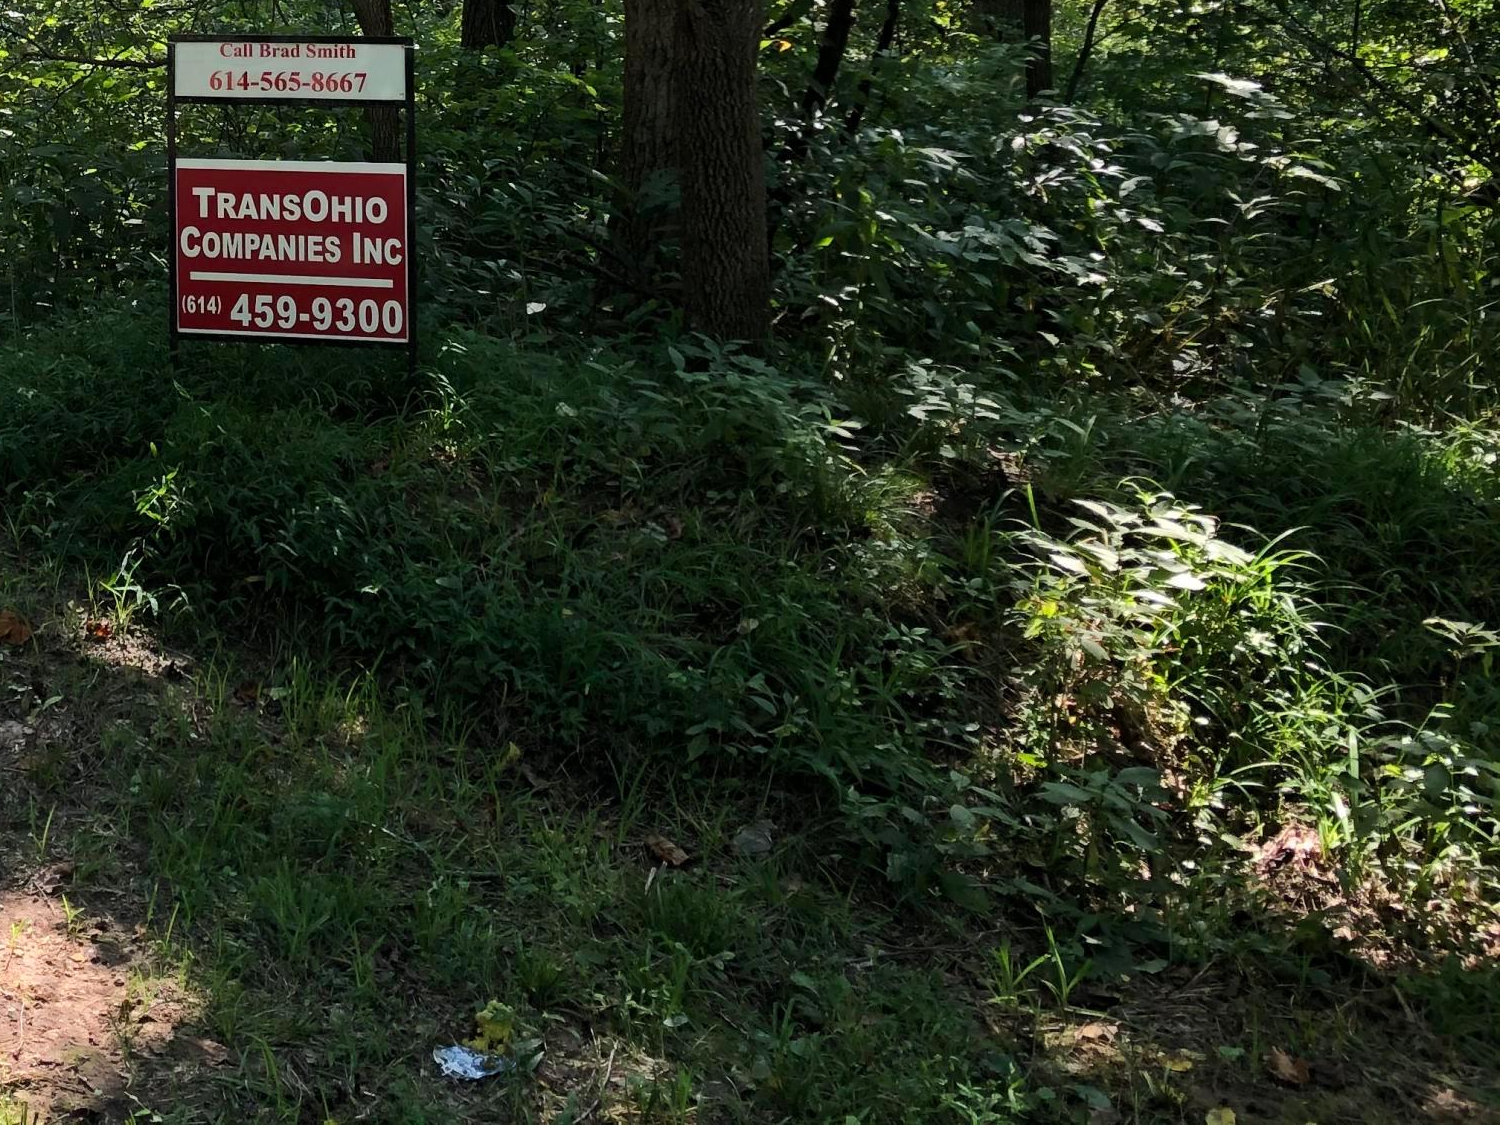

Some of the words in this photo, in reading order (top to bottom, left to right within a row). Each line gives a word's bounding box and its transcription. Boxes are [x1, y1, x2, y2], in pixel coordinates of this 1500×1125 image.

[219, 43, 253, 58] Call
[259, 43, 300, 59] Brad
[306, 44, 357, 59] Smith
[209, 70, 368, 93] 614-565-8667
[353, 232, 402, 266] INC
[182, 295, 222, 315] (614)
[230, 294, 403, 334] 459-9300
